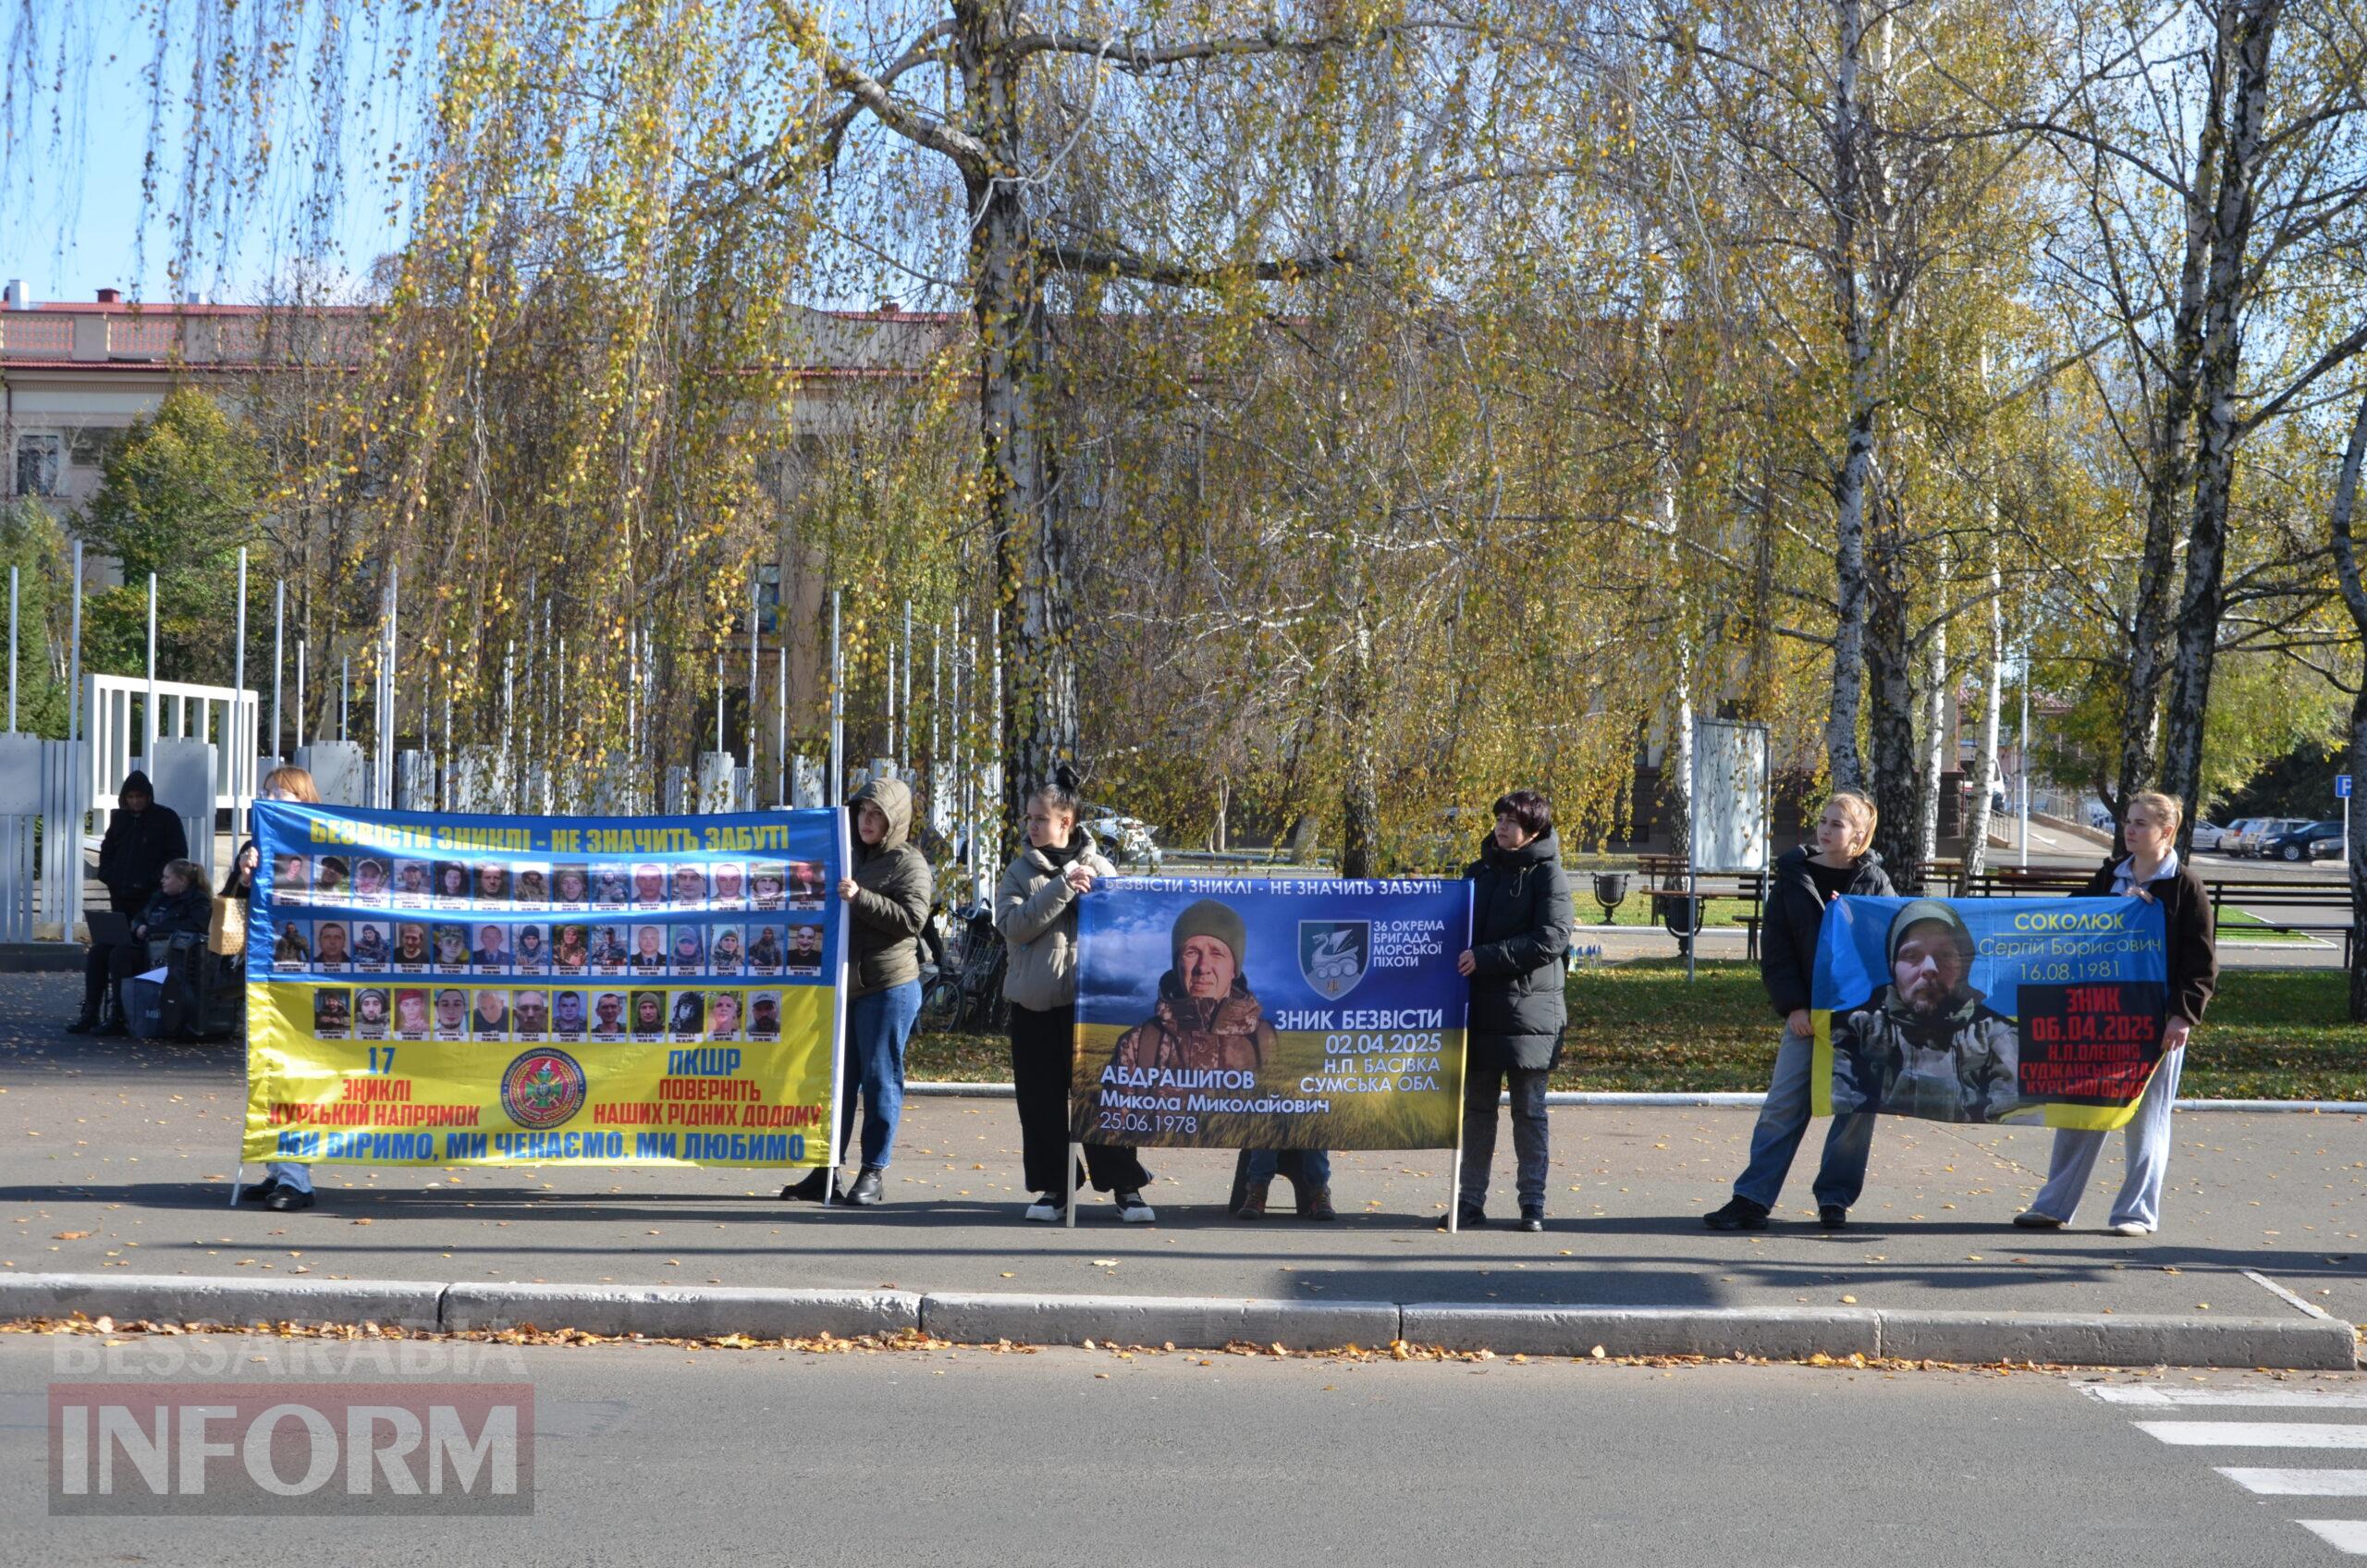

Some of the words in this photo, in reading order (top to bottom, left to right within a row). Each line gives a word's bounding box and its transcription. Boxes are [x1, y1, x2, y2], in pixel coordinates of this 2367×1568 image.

[310, 818, 432, 851] БЕЗВІСТИ
[437, 826, 532, 853] ЗНИКЛІ
[551, 829, 581, 853] НЕ
[586, 827, 700, 853] ЗНАЧИТЬ
[705, 825, 790, 851] ЗАБУТІ
[1189, 879, 1252, 895] ЗНИКЛІ
[1269, 881, 1292, 895] НЕ
[1296, 880, 1374, 895] ЗНАЧИТЬ
[1379, 880, 1442, 895] ЗАБУТІ!
[1373, 921, 1388, 932] 36
[1392, 920, 1445, 932] ОКРЕМА
[2014, 913, 2125, 931] СОКОЛЮК
[1373, 932, 1431, 944] БРИГАДА
[1373, 940, 1443, 955] МОРСЬКОЇ
[1979, 937, 2045, 959] Сергій
[2051, 937, 2162, 959] Борисович
[1373, 956, 1420, 968] ПІХОТИ
[2020, 961, 2120, 981] 16.08.1981
[2065, 987, 2121, 1013] ЗНИК
[1274, 1010, 1335, 1031] ЗНИК
[1342, 1009, 1443, 1030] БЕЗВІСТИ
[2031, 1015, 2155, 1041] 06.04.2025
[1325, 1033, 1442, 1055] 02.04.2025
[368, 1047, 397, 1075] 17
[668, 1048, 742, 1076] ПКШР
[1324, 1059, 1357, 1074] Н.П.
[1364, 1057, 1441, 1073] БАСІВКА
[1100, 1065, 1256, 1090] АБДРАШИТОВ
[1300, 1077, 1392, 1093] СУМСЬКА
[1397, 1076, 1441, 1092] ОБЛ.
[342, 1079, 411, 1101] ЗНИКЛІ
[658, 1078, 761, 1102] ПОВЕРНІТЬ
[1100, 1089, 1181, 1110] Микола
[1187, 1094, 1330, 1114] Миколайович
[269, 1099, 370, 1125] КУРСЬКИЙ
[374, 1104, 481, 1127] НАПРЯМОК
[594, 1102, 664, 1125] НАШИХ
[668, 1103, 738, 1127] РІДНИХ
[741, 1104, 823, 1128] ДОДОМУ
[1099, 1111, 1197, 1134] 25.06.1978
[276, 1131, 320, 1158] МИ
[326, 1131, 439, 1162] ВІРИМО,
[446, 1133, 488, 1160] МИ
[636, 1133, 676, 1159] МИ
[682, 1133, 806, 1161] ЛЮБИМО
